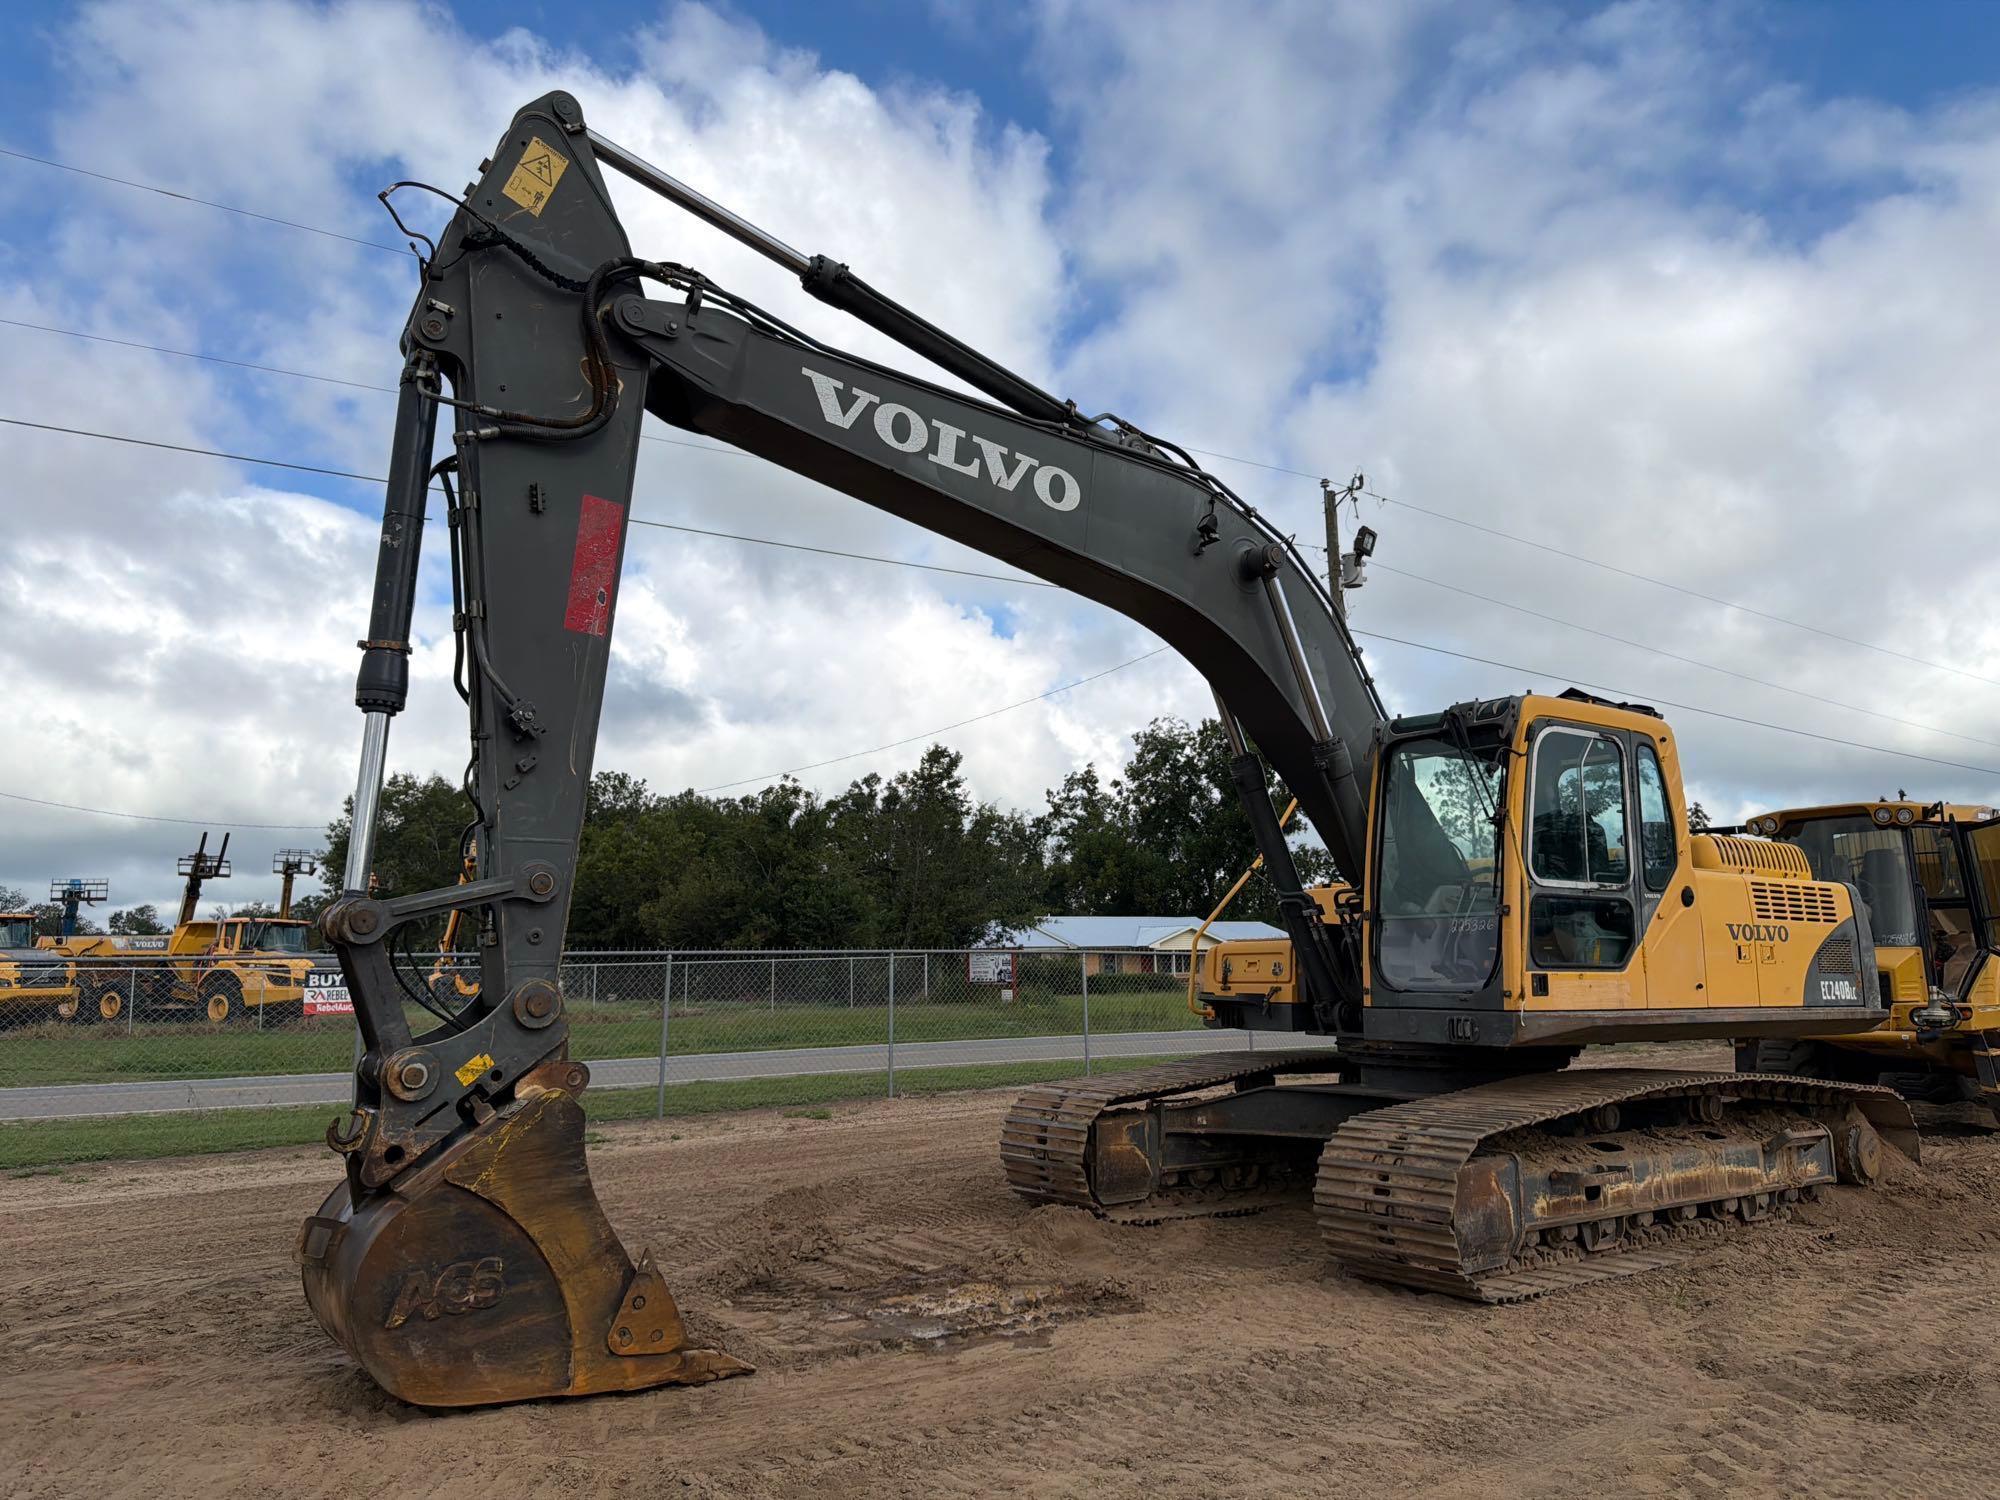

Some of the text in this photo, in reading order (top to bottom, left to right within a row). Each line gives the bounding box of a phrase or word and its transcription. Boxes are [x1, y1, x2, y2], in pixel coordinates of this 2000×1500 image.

[801, 366, 1081, 512] VOLVO
[1725, 923, 1789, 942] VOLVO
[309, 974, 344, 986] BUY
